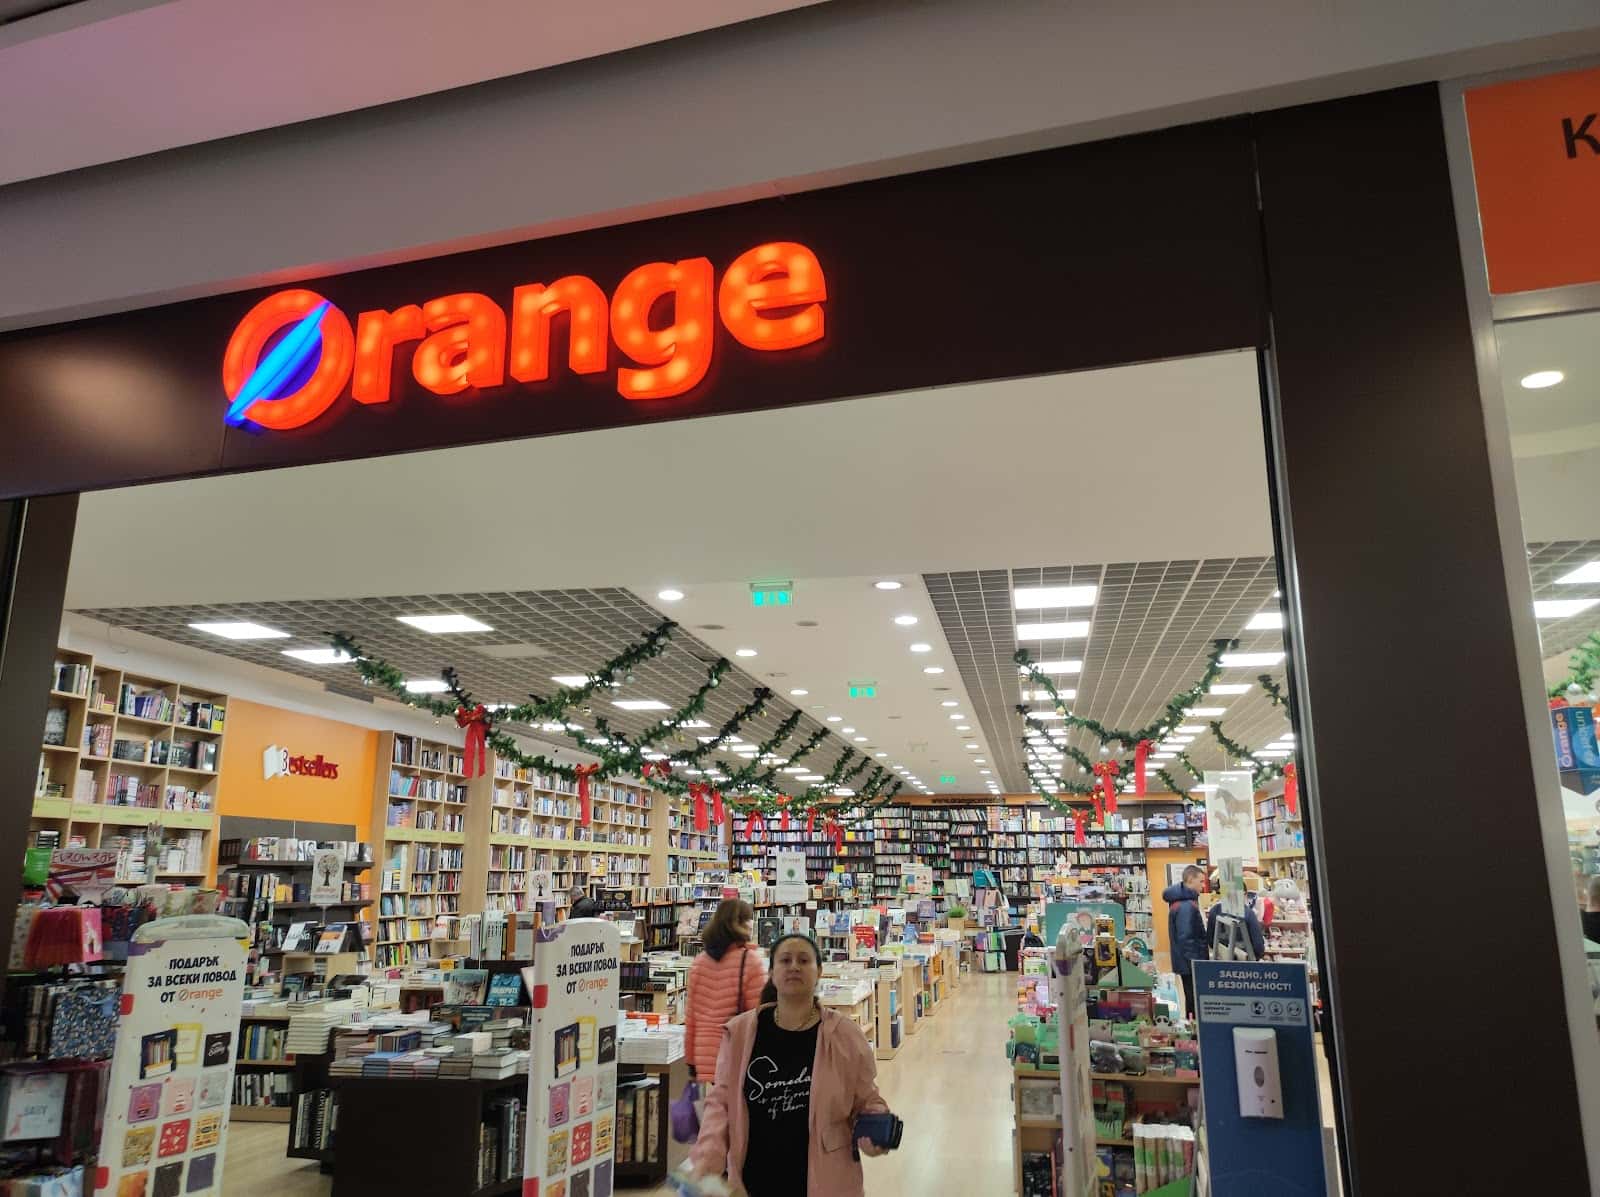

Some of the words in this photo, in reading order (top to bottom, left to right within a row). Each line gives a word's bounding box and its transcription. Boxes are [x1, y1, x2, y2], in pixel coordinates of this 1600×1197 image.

[222, 241, 828, 430] Orange
[571, 942, 605, 957] ПОДАРЪК
[169, 956, 220, 970] ПОДАРЪК
[556, 964, 567, 977] ЗА
[569, 960, 593, 976] ВСЕКИ
[593, 957, 618, 972] ПОВОД
[147, 975, 162, 988] ЗА
[165, 972, 201, 987] ВСЕКИ
[202, 970, 237, 984] ПОВОД
[1219, 970, 1262, 980] ЗАЕДНО,
[1264, 971, 1279, 980] НО
[566, 981, 577, 995] ОТ
[578, 978, 609, 992] Orange
[1208, 981, 1216, 989] В
[160, 990, 176, 1003] ОТ
[178, 988, 224, 1001] Orange
[747, 1055, 811, 1101] Someda
[771, 1086, 790, 1102] not
[767, 1101, 778, 1121] of
